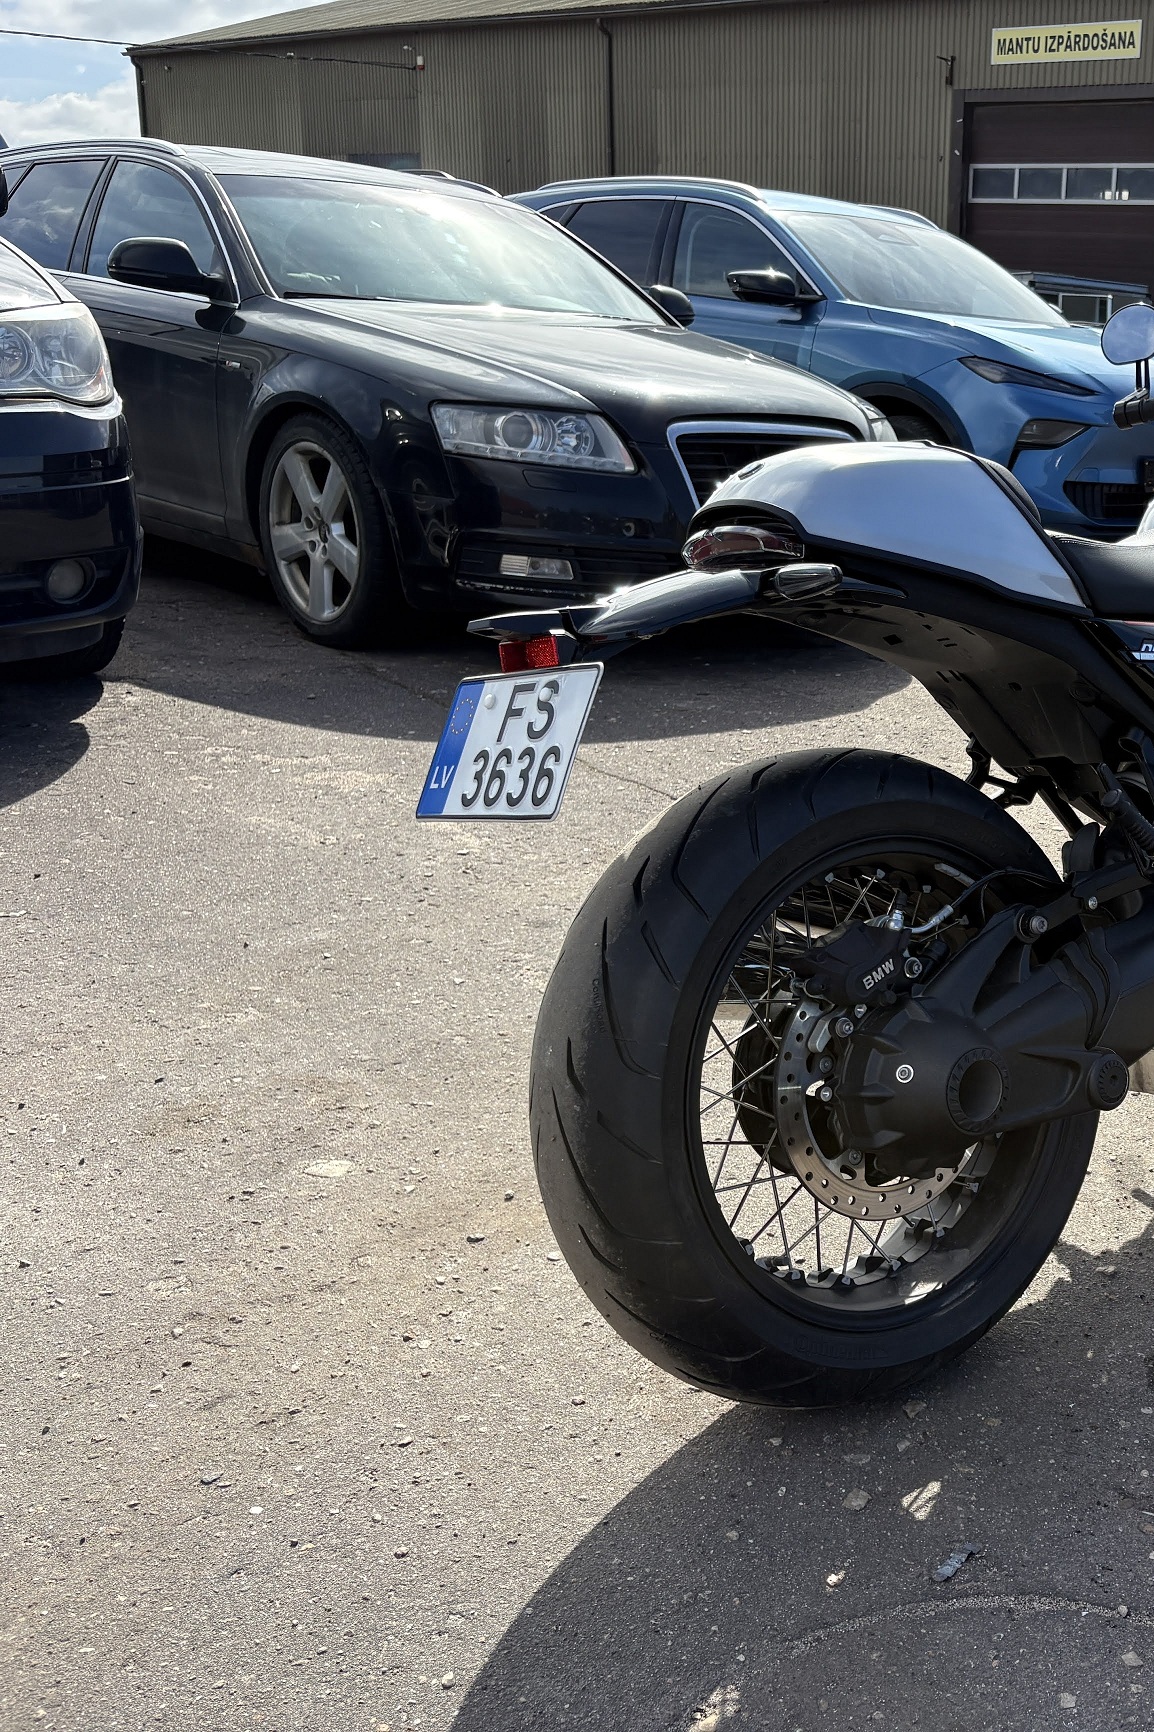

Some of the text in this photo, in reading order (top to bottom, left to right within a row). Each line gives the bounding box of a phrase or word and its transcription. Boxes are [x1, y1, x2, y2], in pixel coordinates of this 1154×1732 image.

[996, 28, 1136, 56] MANTU IZPĀRDOŠANA
[496, 680, 560, 743] FS
[430, 765, 455, 789] LV
[461, 745, 561, 808] 3636
[862, 958, 895, 990] BMW
